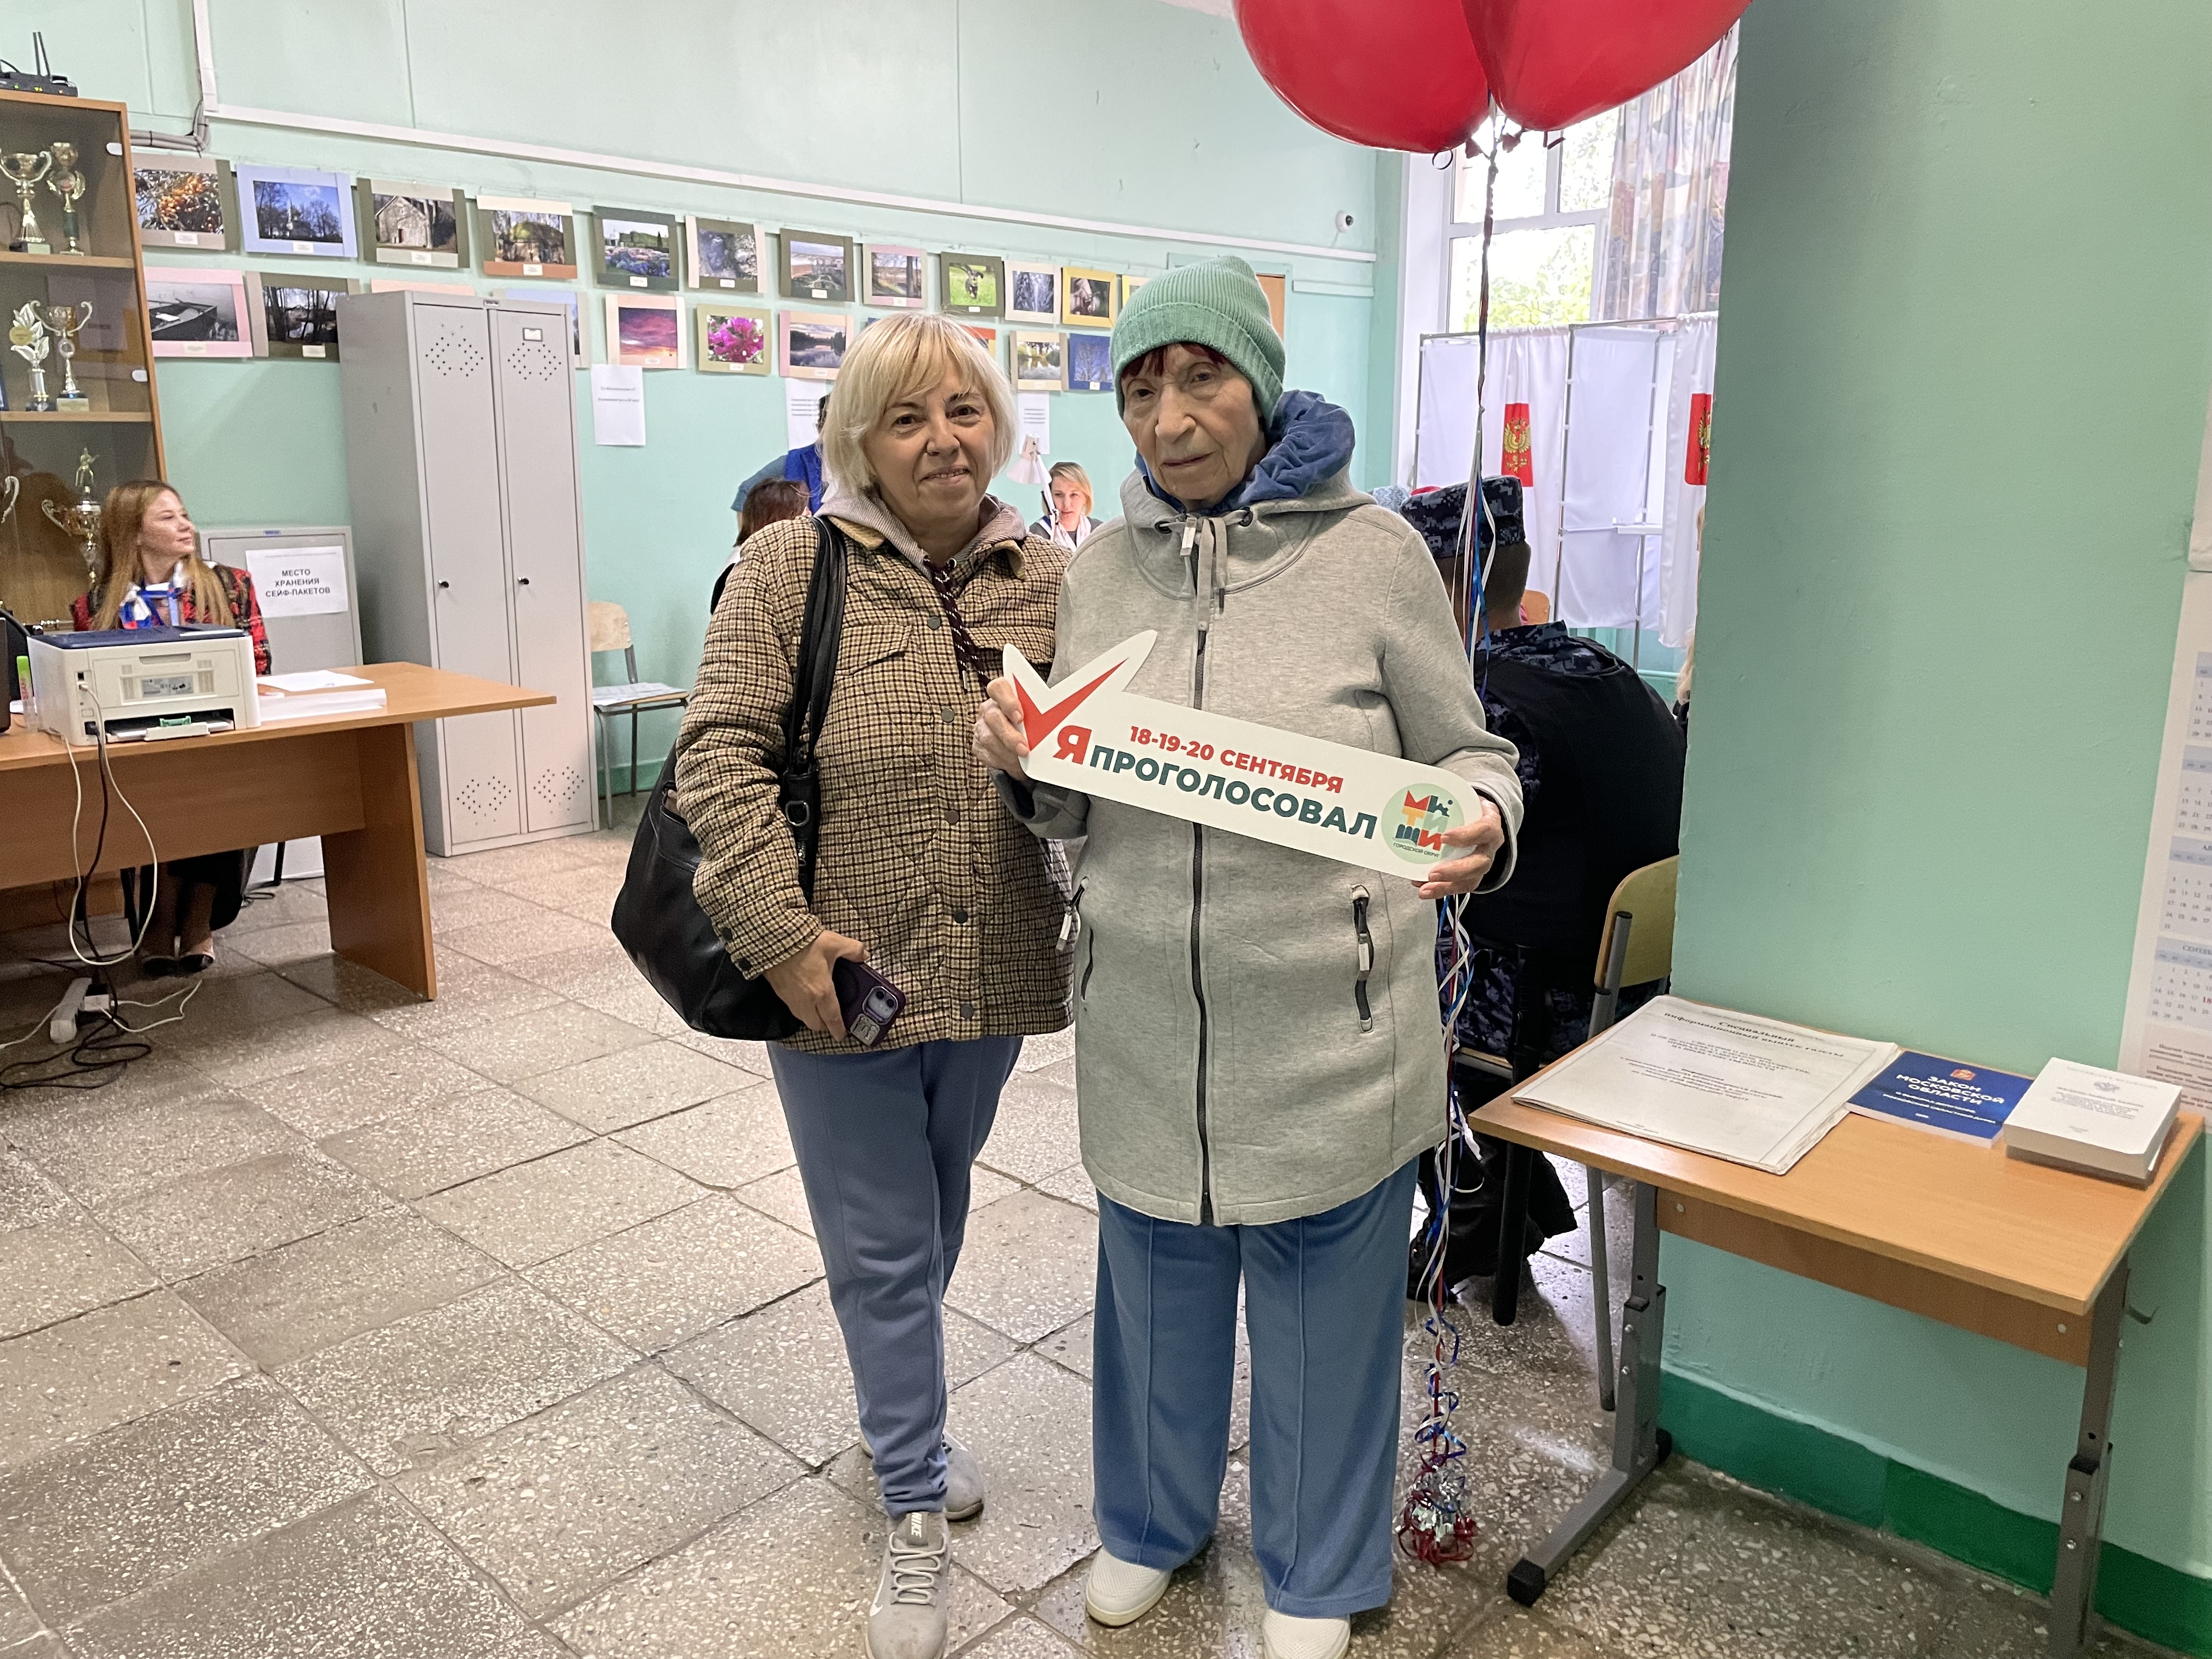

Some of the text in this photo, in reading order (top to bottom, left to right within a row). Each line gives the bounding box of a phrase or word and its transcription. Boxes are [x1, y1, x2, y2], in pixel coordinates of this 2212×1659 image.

[275, 578, 319, 587] ХРАНЕНИЯ
[282, 568, 311, 577] МЕСТО
[266, 587, 330, 597] СЕЙФ-ПАКЕТОВ
[1130, 726, 1344, 793] 18-19-20 СЕНТЯБРЯ
[1053, 725, 1378, 839] Я ПРОГОЛОСОВАЛ
[1393, 842, 1423, 853] ГОРОДСКОЙ
[1664, 1013, 1759, 1040] информационный
[1719, 1022, 1795, 1042] Специальный
[1896, 1074, 2005, 1104] МОСКОВСКОЙ
[1927, 1076, 1982, 1092] ЗАКОН
[1908, 1084, 1982, 1105] ОБЛАСТИ
[911, 1512, 922, 1538] NIKE
